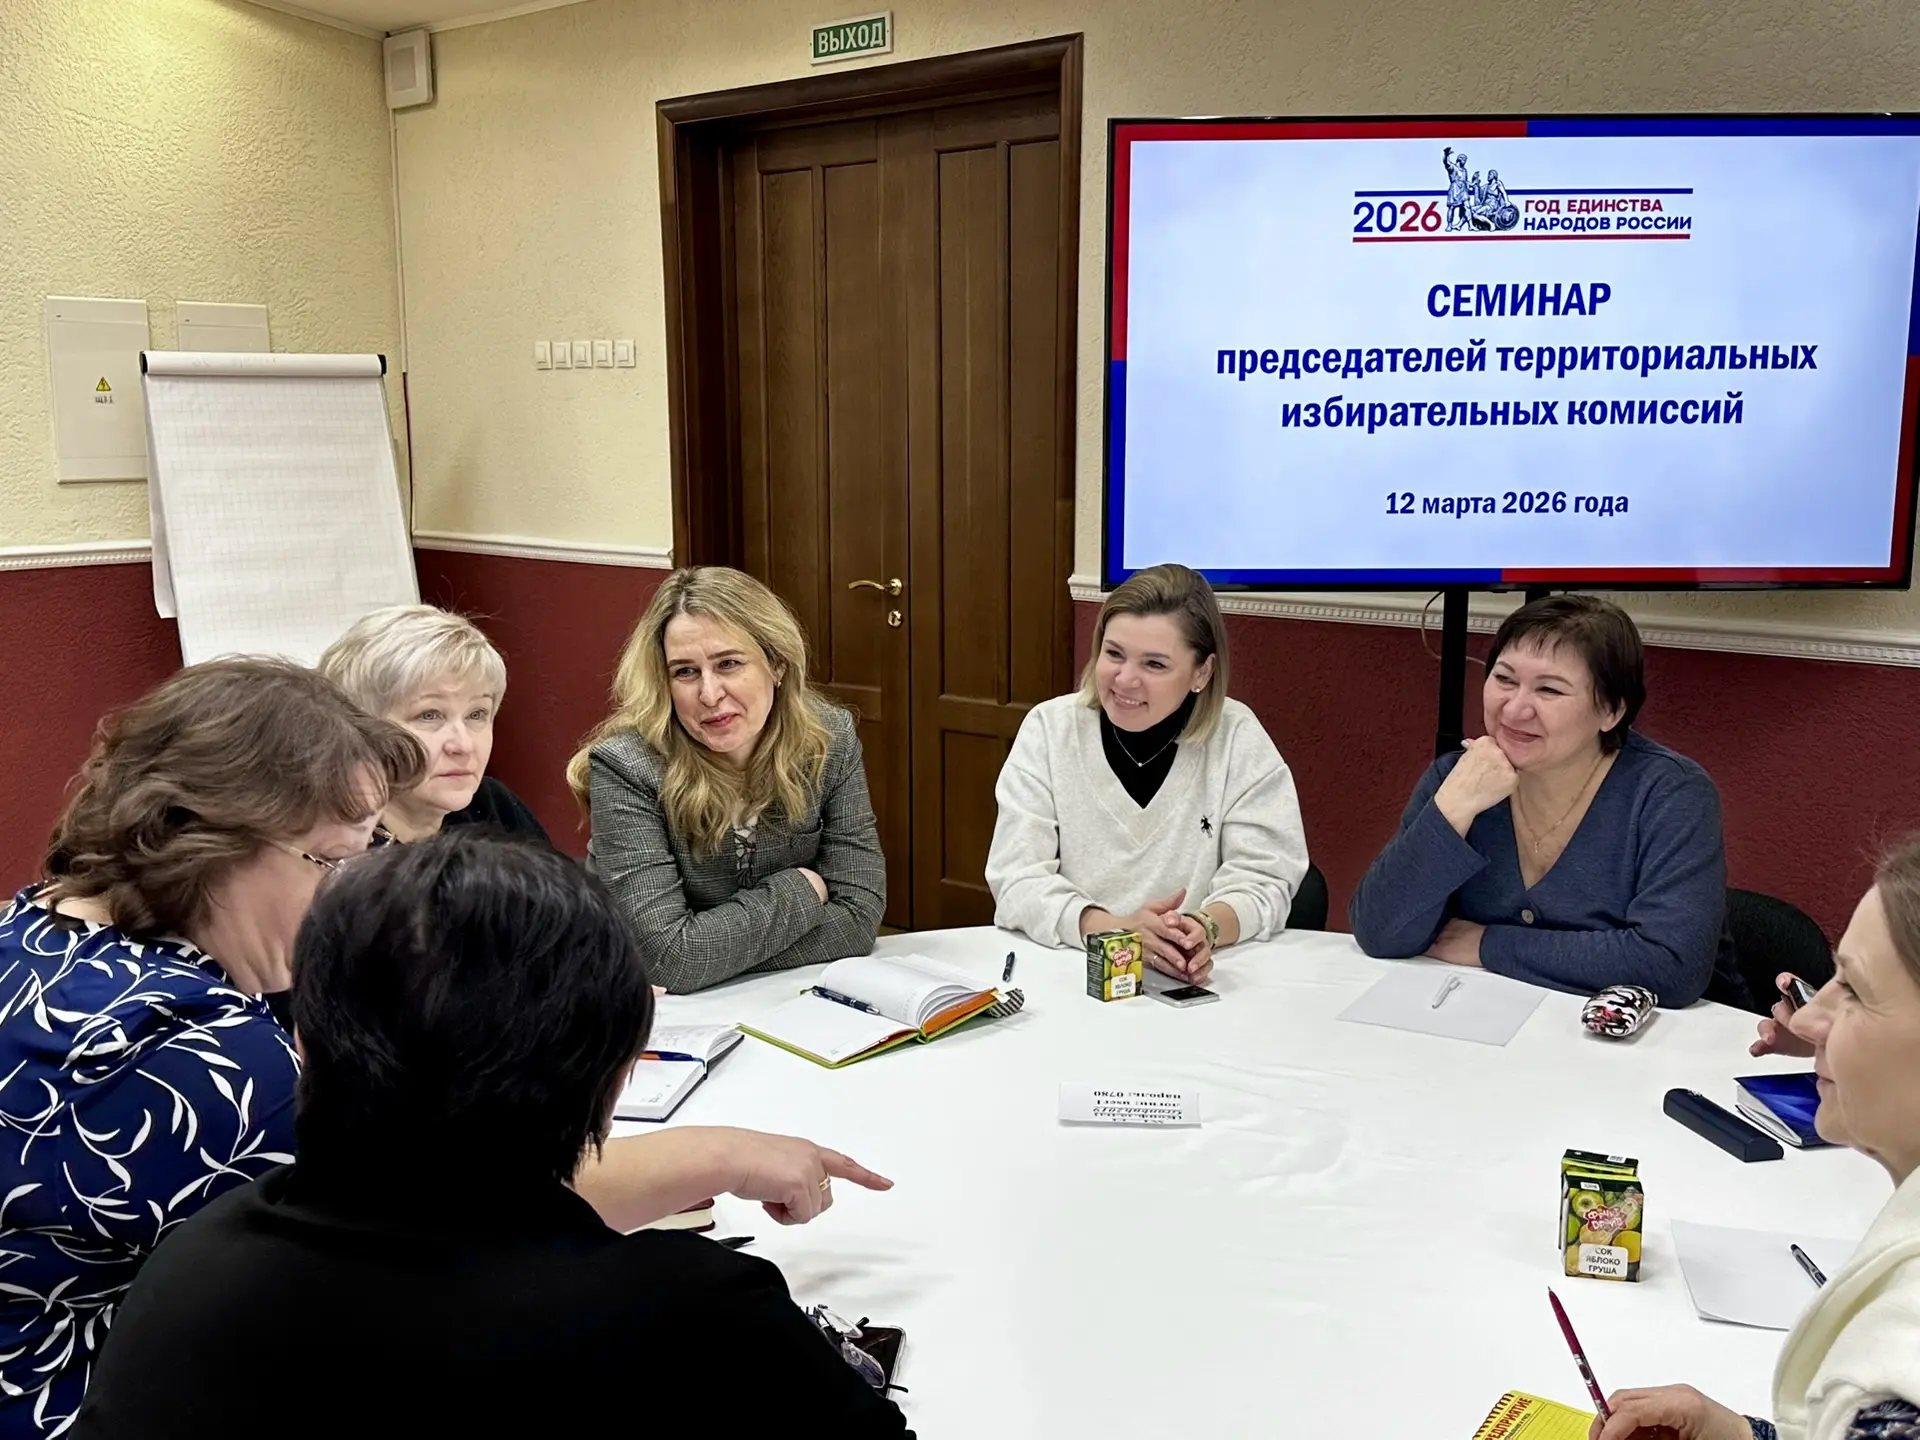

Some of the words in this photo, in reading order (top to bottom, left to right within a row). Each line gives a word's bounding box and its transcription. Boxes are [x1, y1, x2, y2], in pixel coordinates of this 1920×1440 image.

[818, 22, 884, 54] ВЫХОД
[1353, 201, 1442, 233] 2026
[1524, 199, 1561, 215] ГОД
[1566, 198, 1664, 214] ЕДИНСТВА
[1523, 216, 1611, 233] НАРОДОВ
[1616, 216, 1692, 231] РОССИИ
[1427, 283, 1612, 318] СЕМИНАР
[1216, 338, 1486, 381] председателей
[1496, 344, 1818, 378] территориальных
[1281, 394, 1559, 434] избирательных
[1567, 391, 1744, 425] комиссий
[1386, 492, 1415, 514] 12
[1422, 497, 1496, 519] марта
[1502, 491, 1567, 514] 2026
[1574, 496, 1629, 517] года
[1586, 1255, 1620, 1266] ЯБЛОКО
[1595, 1247, 1613, 1256] СОК
[1588, 1265, 1617, 1275] ГРУША
